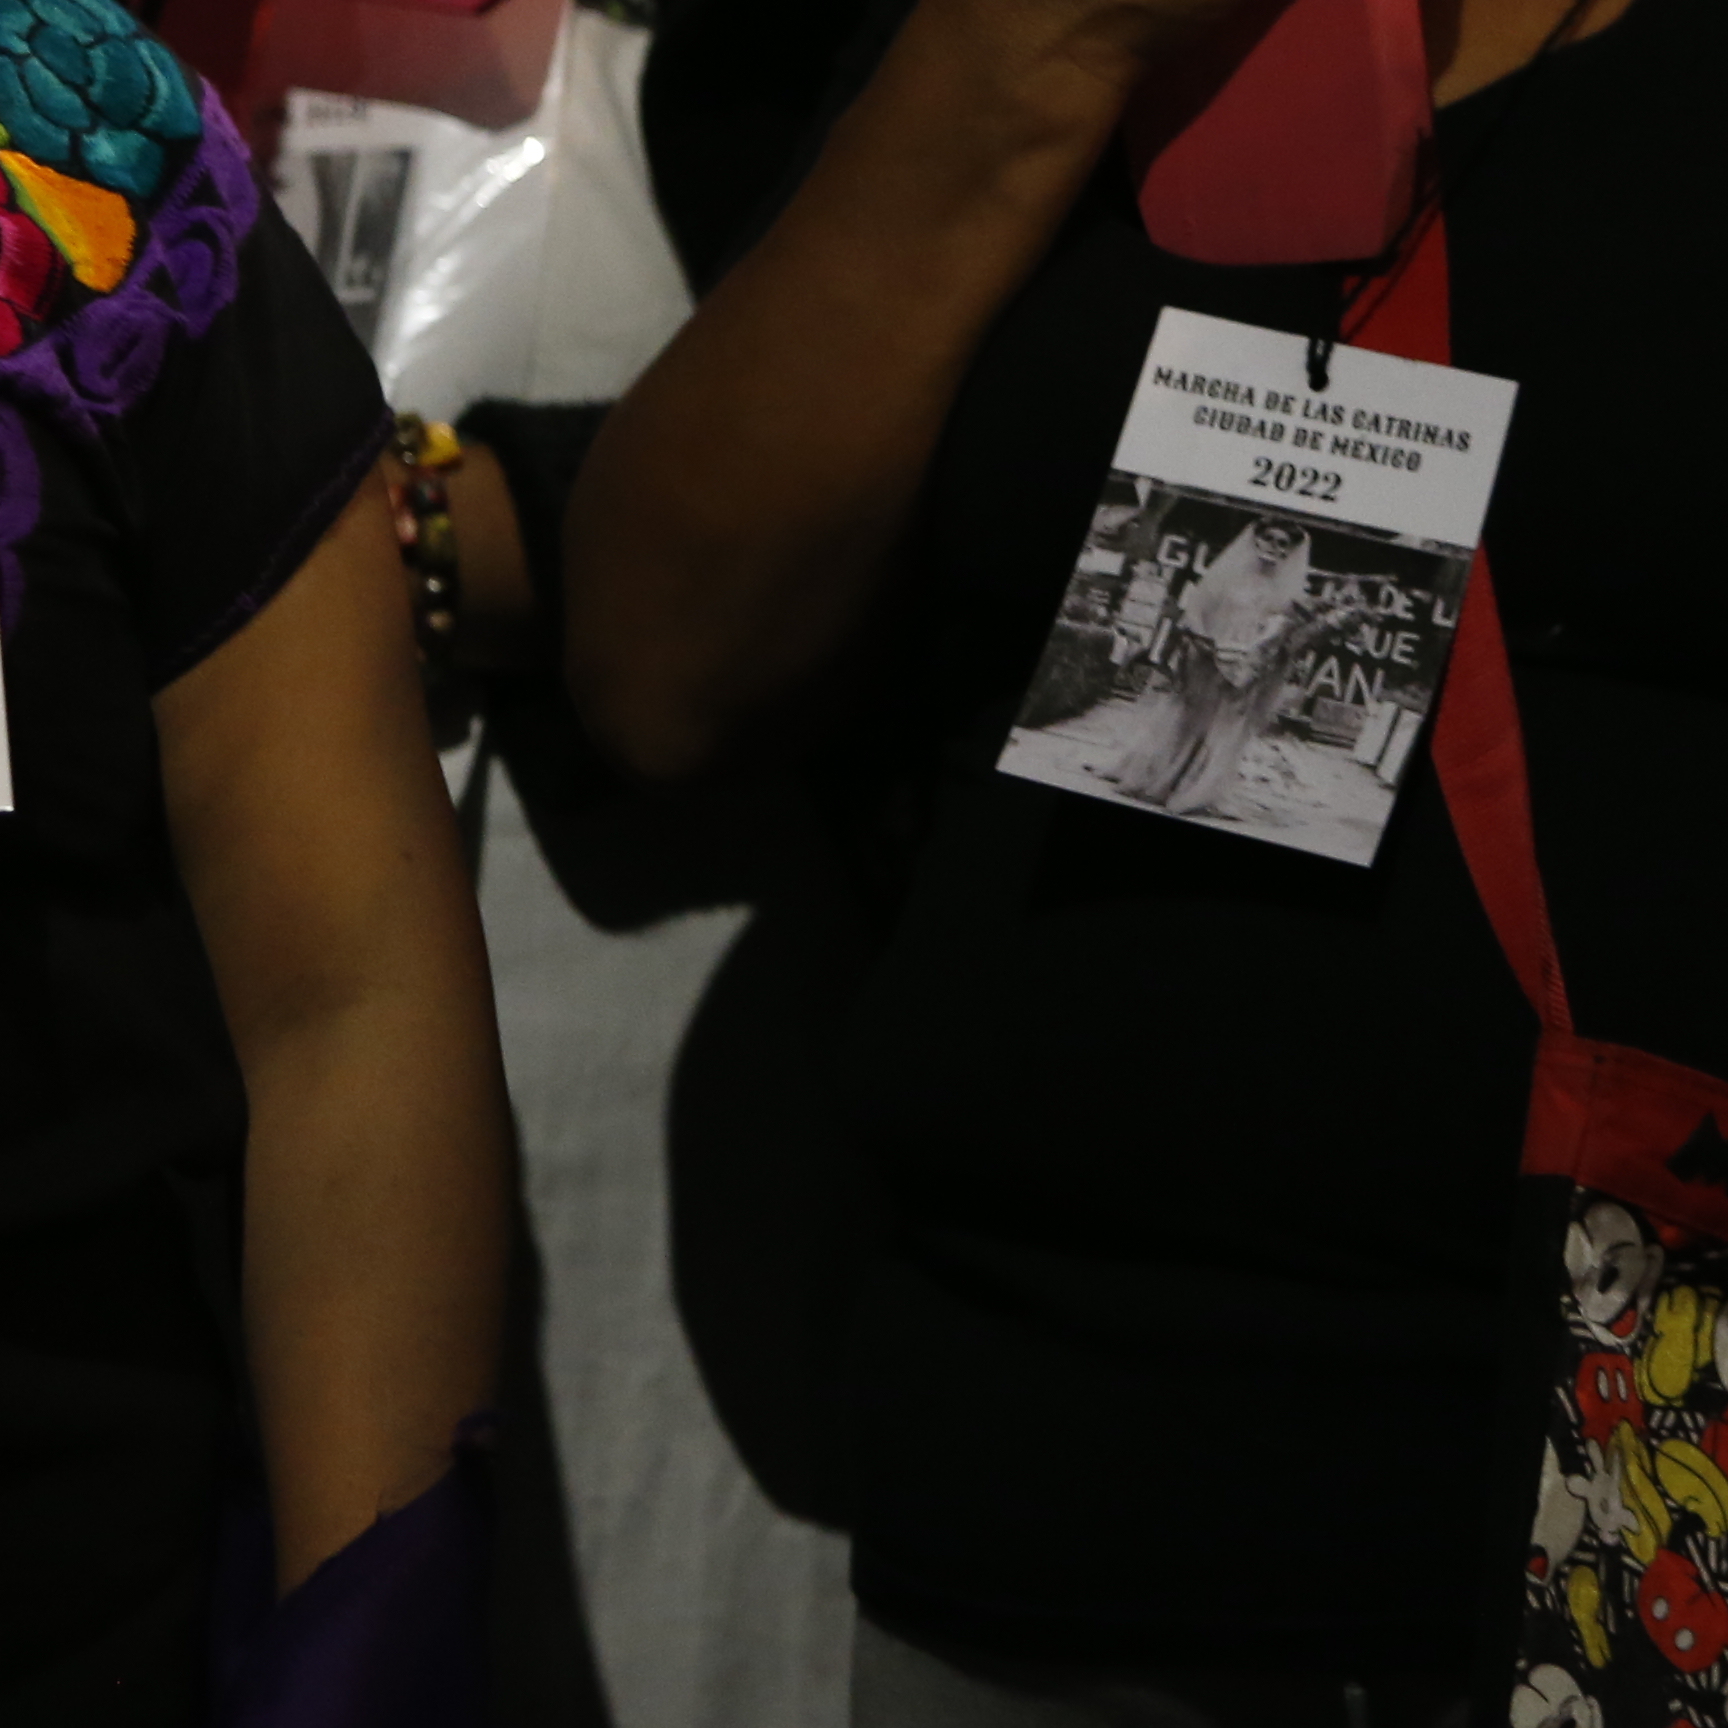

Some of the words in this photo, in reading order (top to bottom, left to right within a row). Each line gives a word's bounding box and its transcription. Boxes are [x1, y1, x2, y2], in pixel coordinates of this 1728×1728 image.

[1152, 366, 1255, 407] MARCHA
[1264, 390, 1296, 415] DE
[1302, 398, 1345, 425] LAS
[1351, 408, 1472, 452] CATRINAS
[1192, 404, 1285, 442] CIUDAD
[1293, 426, 1324, 450] DE
[1249, 456, 1342, 502] 2022
